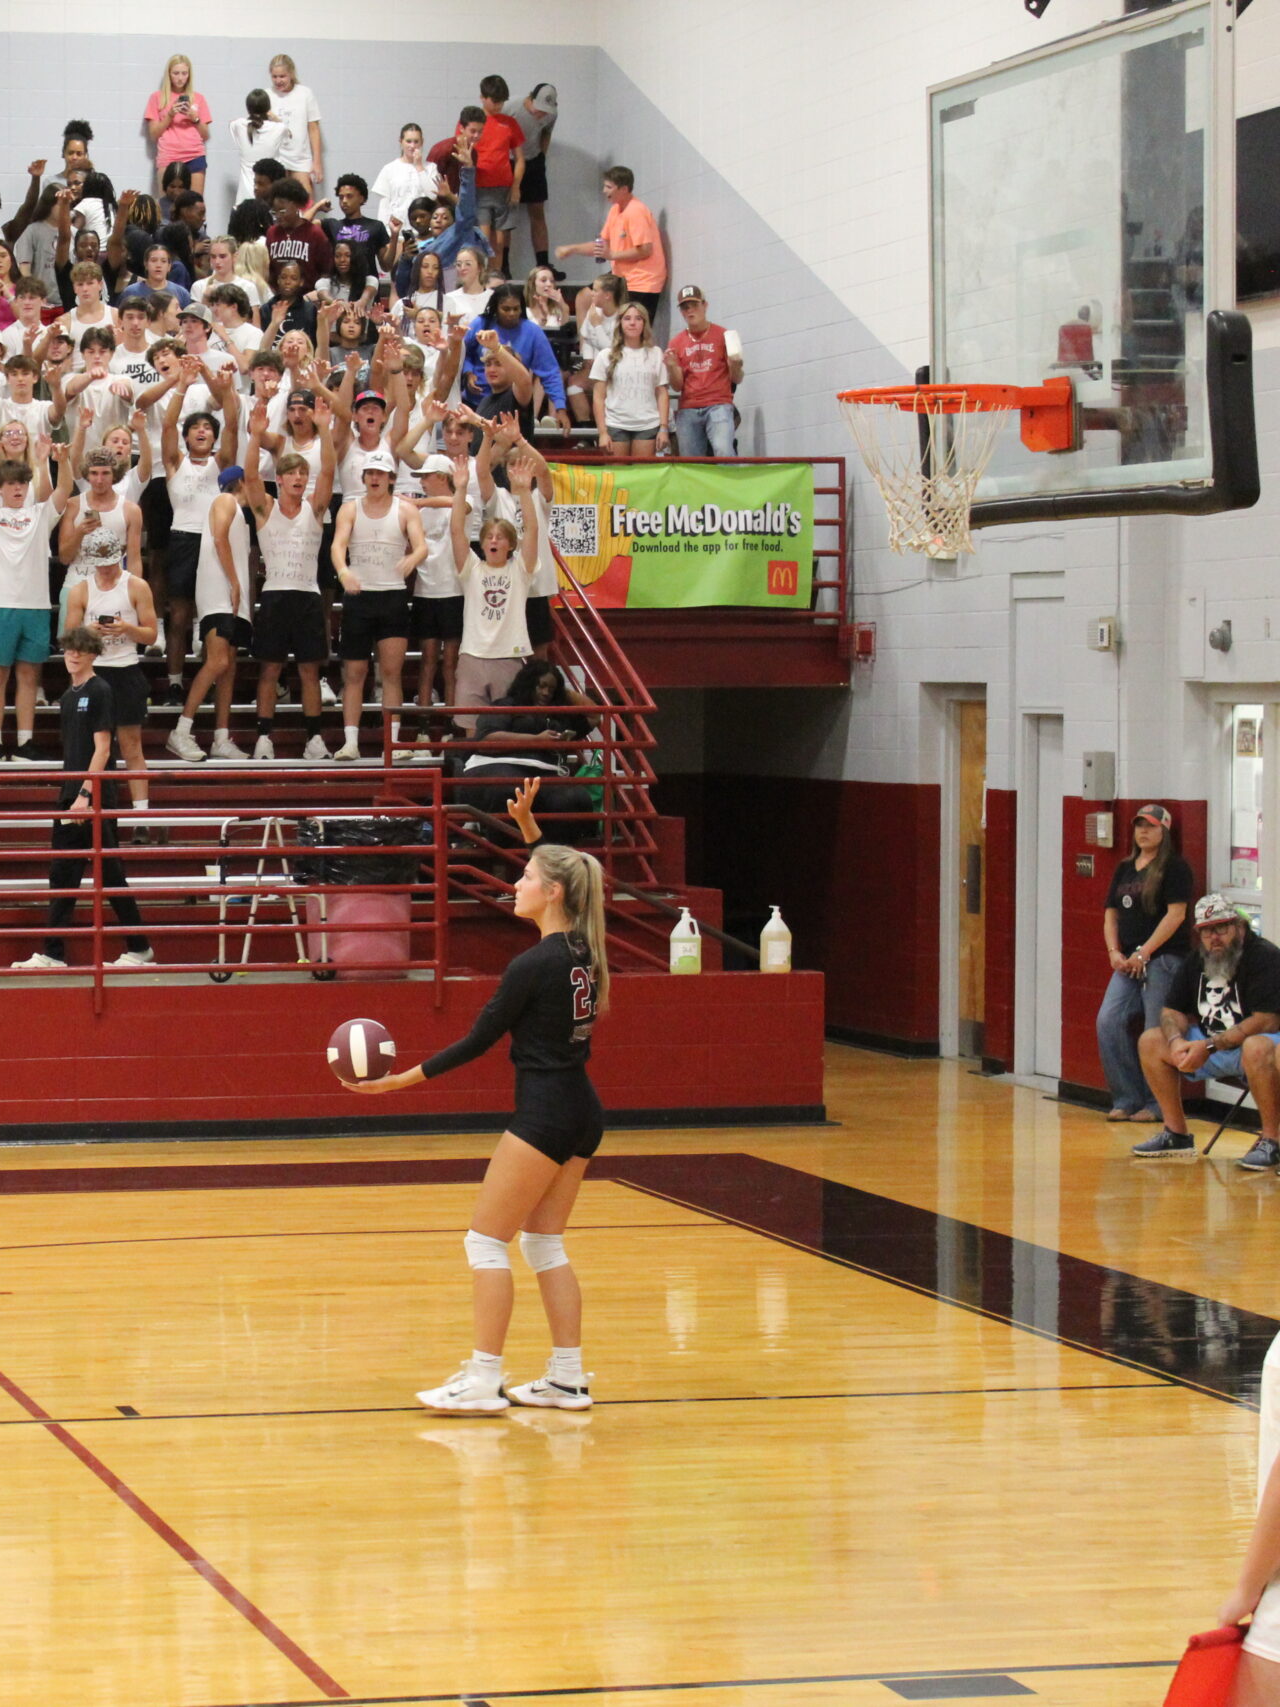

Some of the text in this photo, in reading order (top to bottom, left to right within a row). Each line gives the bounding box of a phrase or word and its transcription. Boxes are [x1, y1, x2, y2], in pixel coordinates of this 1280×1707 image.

[270, 240, 310, 262] FLORIDA
[126, 364, 145, 373] JUST
[611, 501, 802, 538] Free McDonald's
[632, 538, 784, 555] Download the app for free food.
[570, 966, 599, 1020] 2
